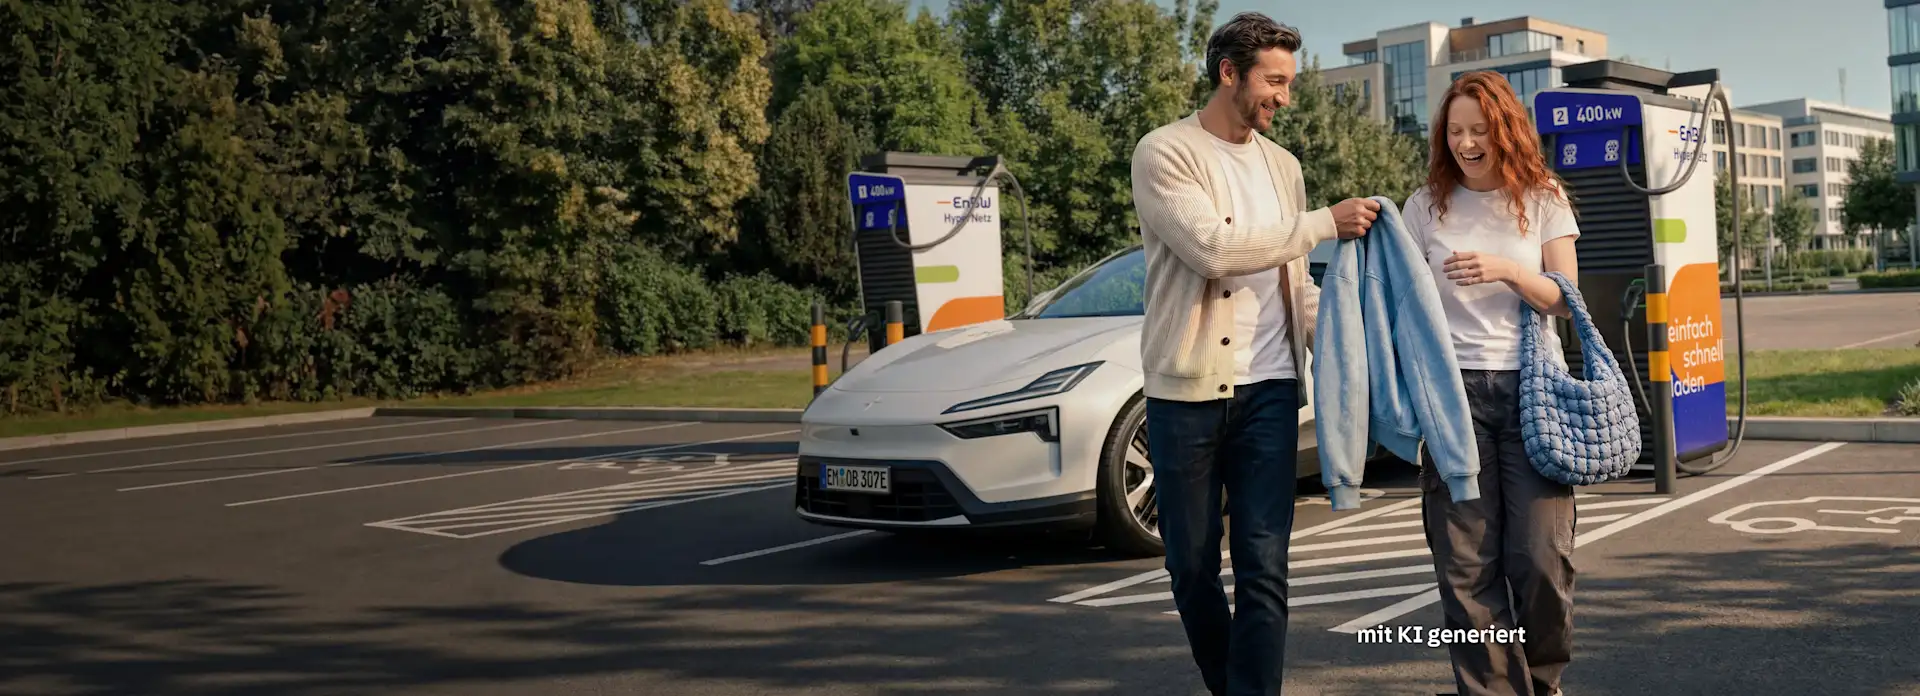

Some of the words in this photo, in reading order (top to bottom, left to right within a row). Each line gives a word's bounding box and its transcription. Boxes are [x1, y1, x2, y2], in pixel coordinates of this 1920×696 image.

[1576, 106, 1604, 123] 400
[1679, 125, 1707, 144] EnB
[1668, 314, 1714, 343] einfach
[1683, 339, 1724, 368] schnell
[1670, 372, 1705, 398] laden
[827, 468, 839, 487] EM
[861, 470, 887, 489] 307E
